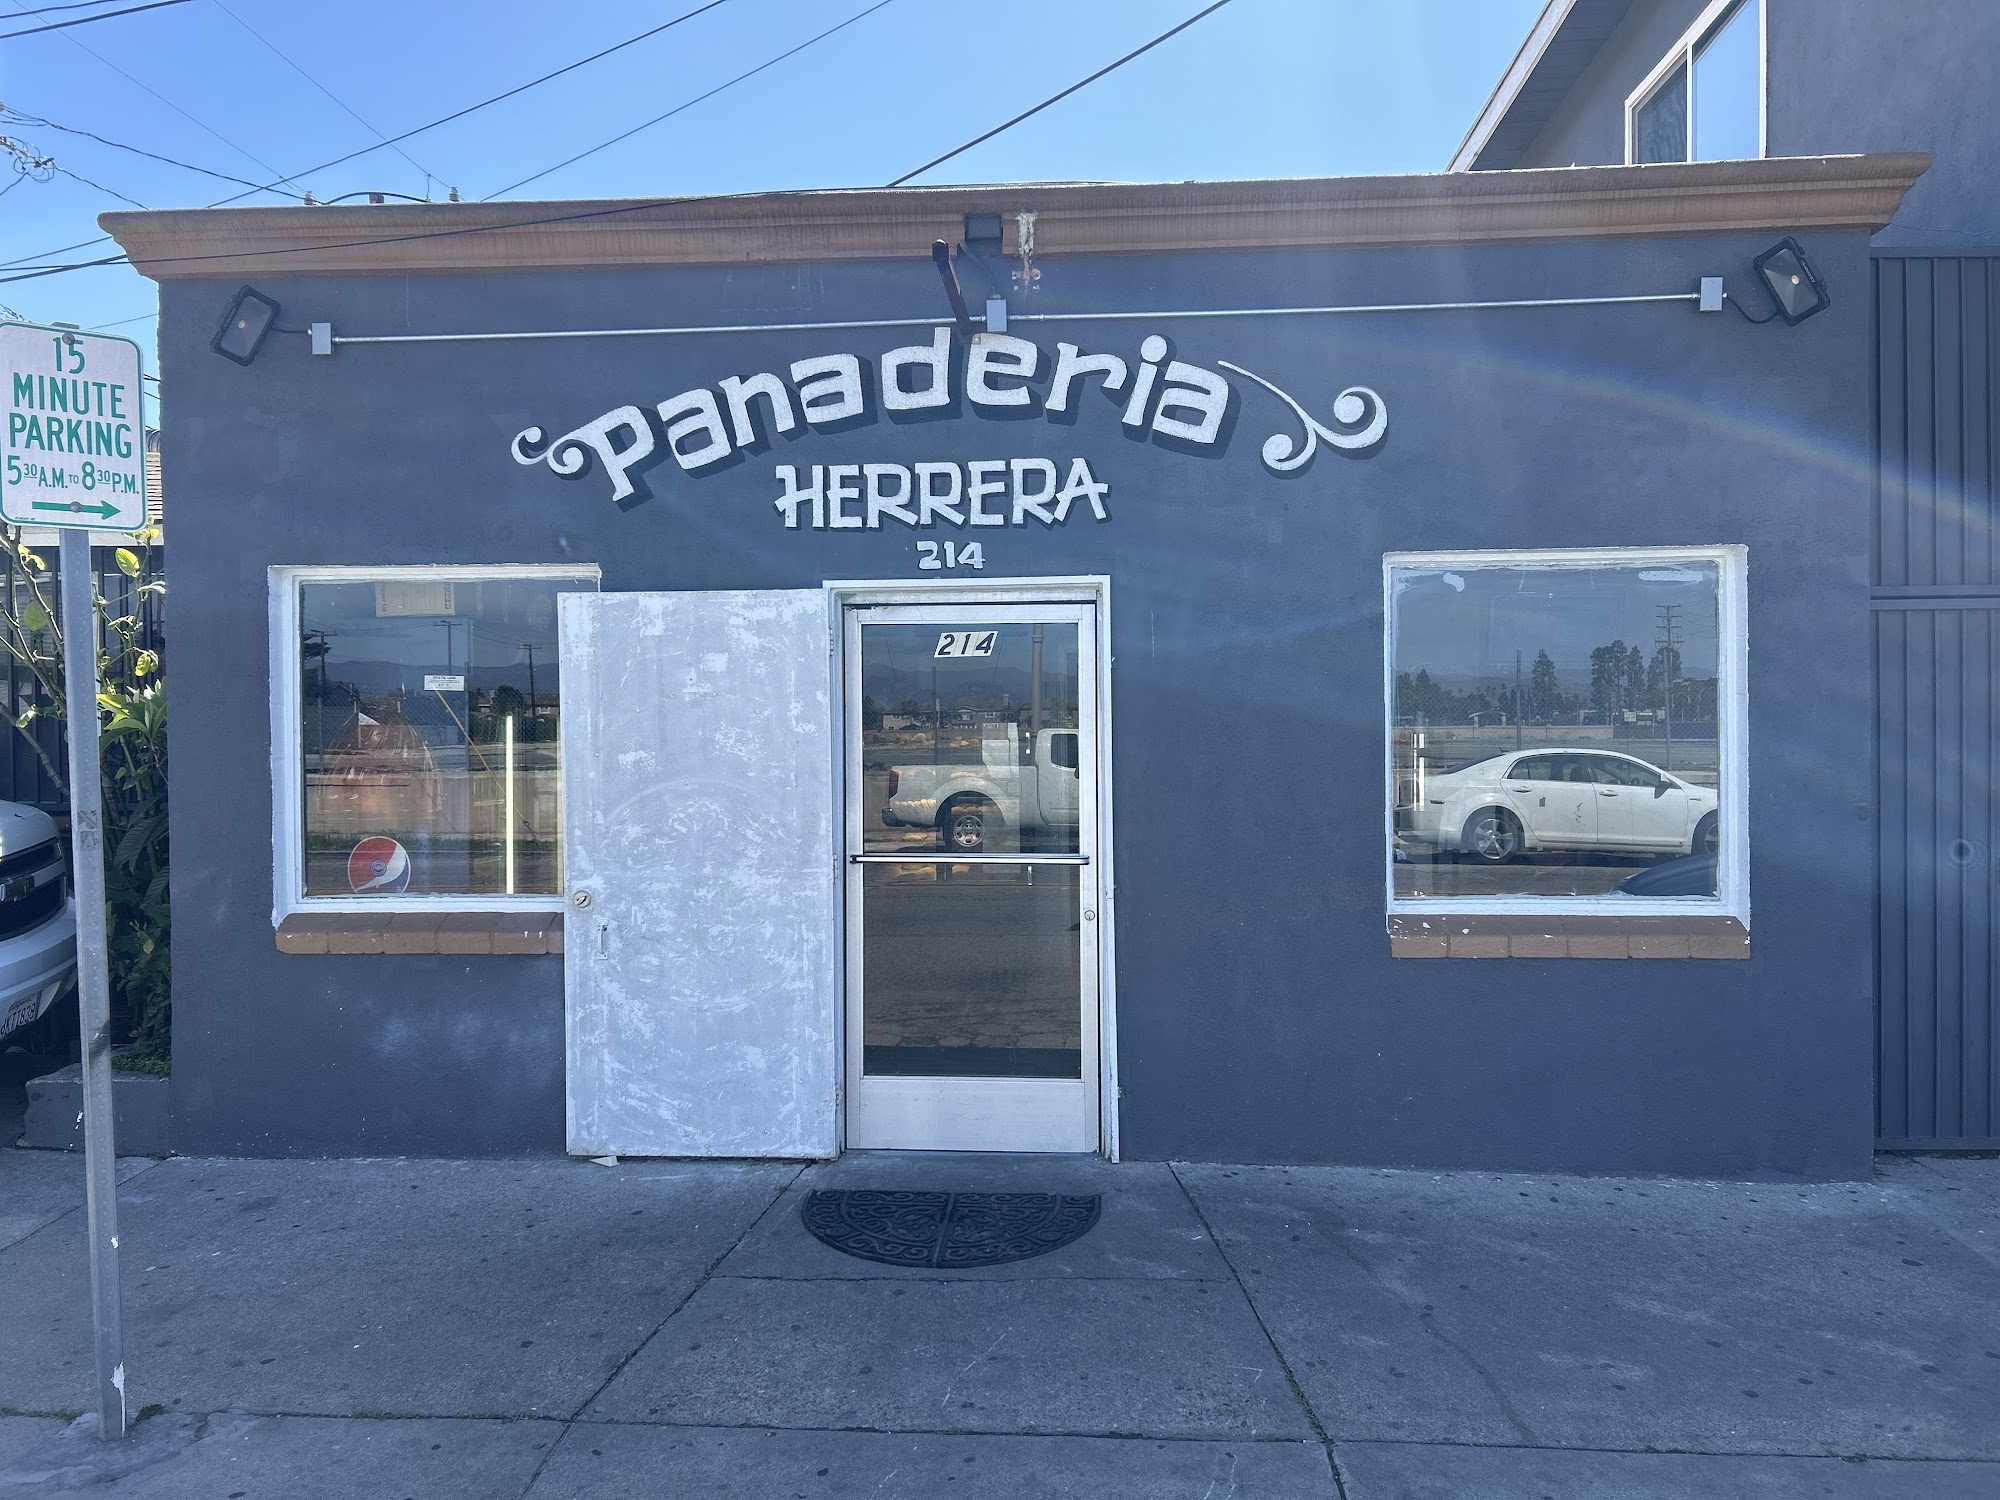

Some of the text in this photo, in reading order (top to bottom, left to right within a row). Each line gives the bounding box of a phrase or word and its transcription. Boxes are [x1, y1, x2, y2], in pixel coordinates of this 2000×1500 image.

[53, 336, 85, 374] 15
[13, 371, 126, 419] MINUTE
[560, 327, 1229, 501] Panaderia
[9, 412, 132, 459] PARKING
[774, 457, 1108, 528] HERRERA
[916, 540, 985, 569] 214
[937, 632, 995, 655] 214
